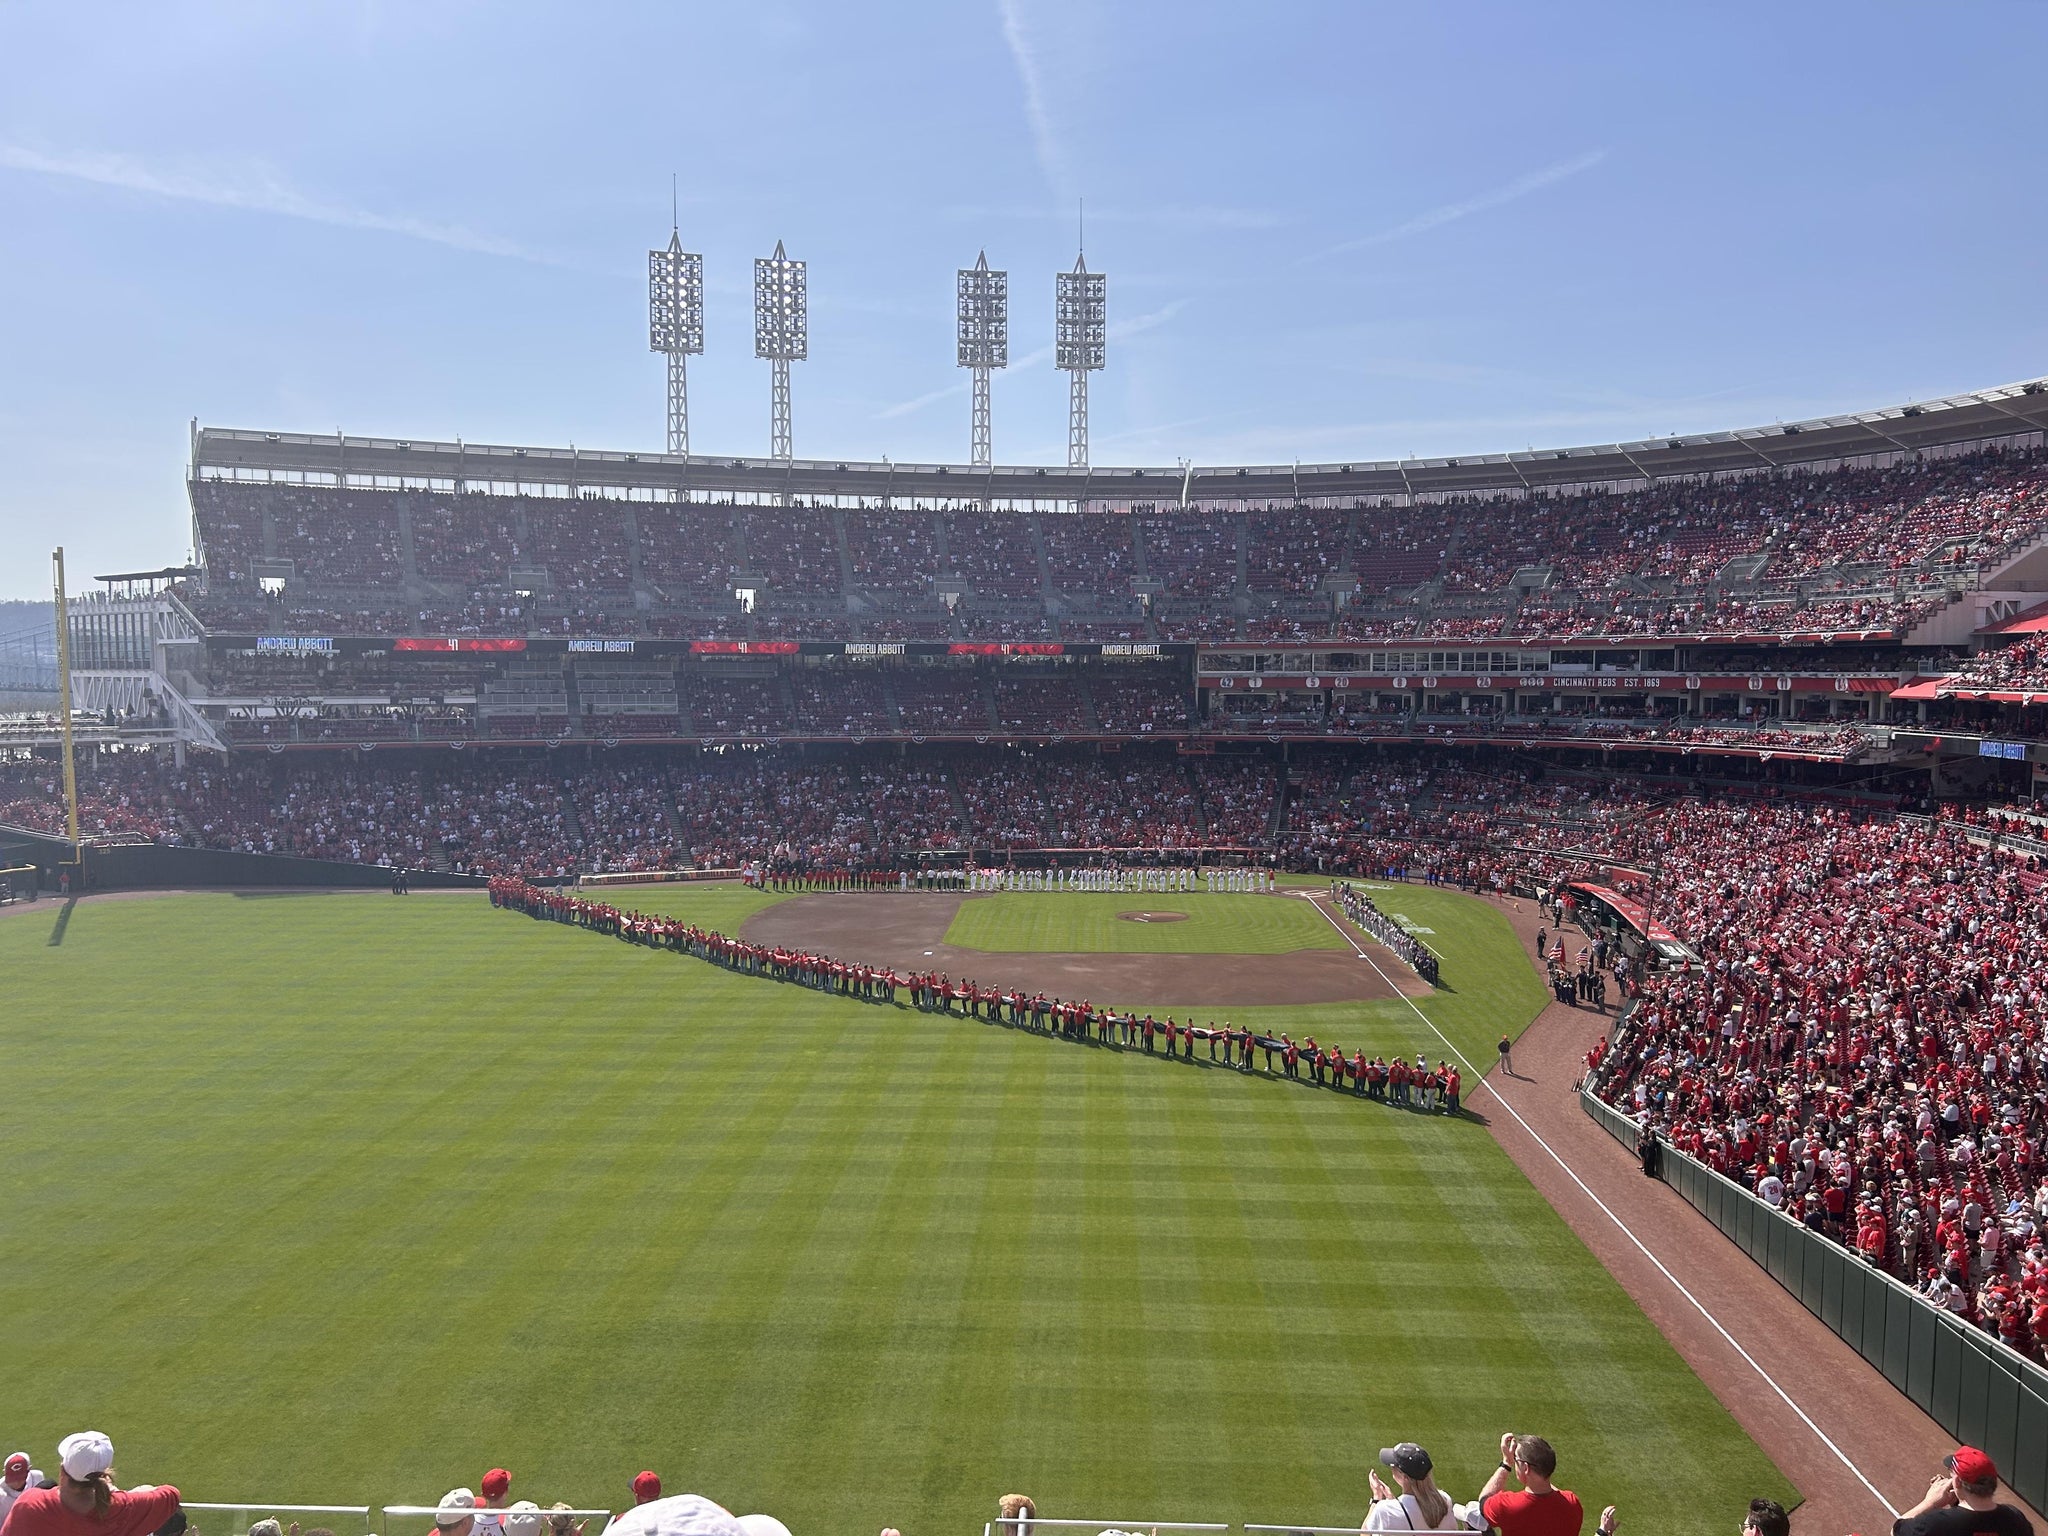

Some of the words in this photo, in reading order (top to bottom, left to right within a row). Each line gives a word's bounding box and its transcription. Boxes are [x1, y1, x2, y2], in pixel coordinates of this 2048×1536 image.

[257, 637, 297, 650] ANDREW
[299, 638, 334, 650] ABBOTT
[448, 639, 458, 651] 41
[568, 640, 603, 652] ANDREW
[604, 641, 635, 652] ABBOTT
[738, 642, 748, 654] 41
[845, 643, 876, 654] ANDREW
[877, 643, 906, 655] ABBOTT
[1001, 644, 1010, 655] 41
[1101, 644, 1132, 655] ANDREW
[1133, 644, 1161, 655] ABBOTT
[1336, 677, 1348, 688] 20
[1553, 678, 1595, 687] CINCINNATI
[1598, 678, 1617, 687] REDS
[1624, 678, 1641, 687] EST.
[1644, 678, 1660, 688] 1869
[607, 875, 637, 883] GORILLA
[11, 1463, 22, 1471] C
